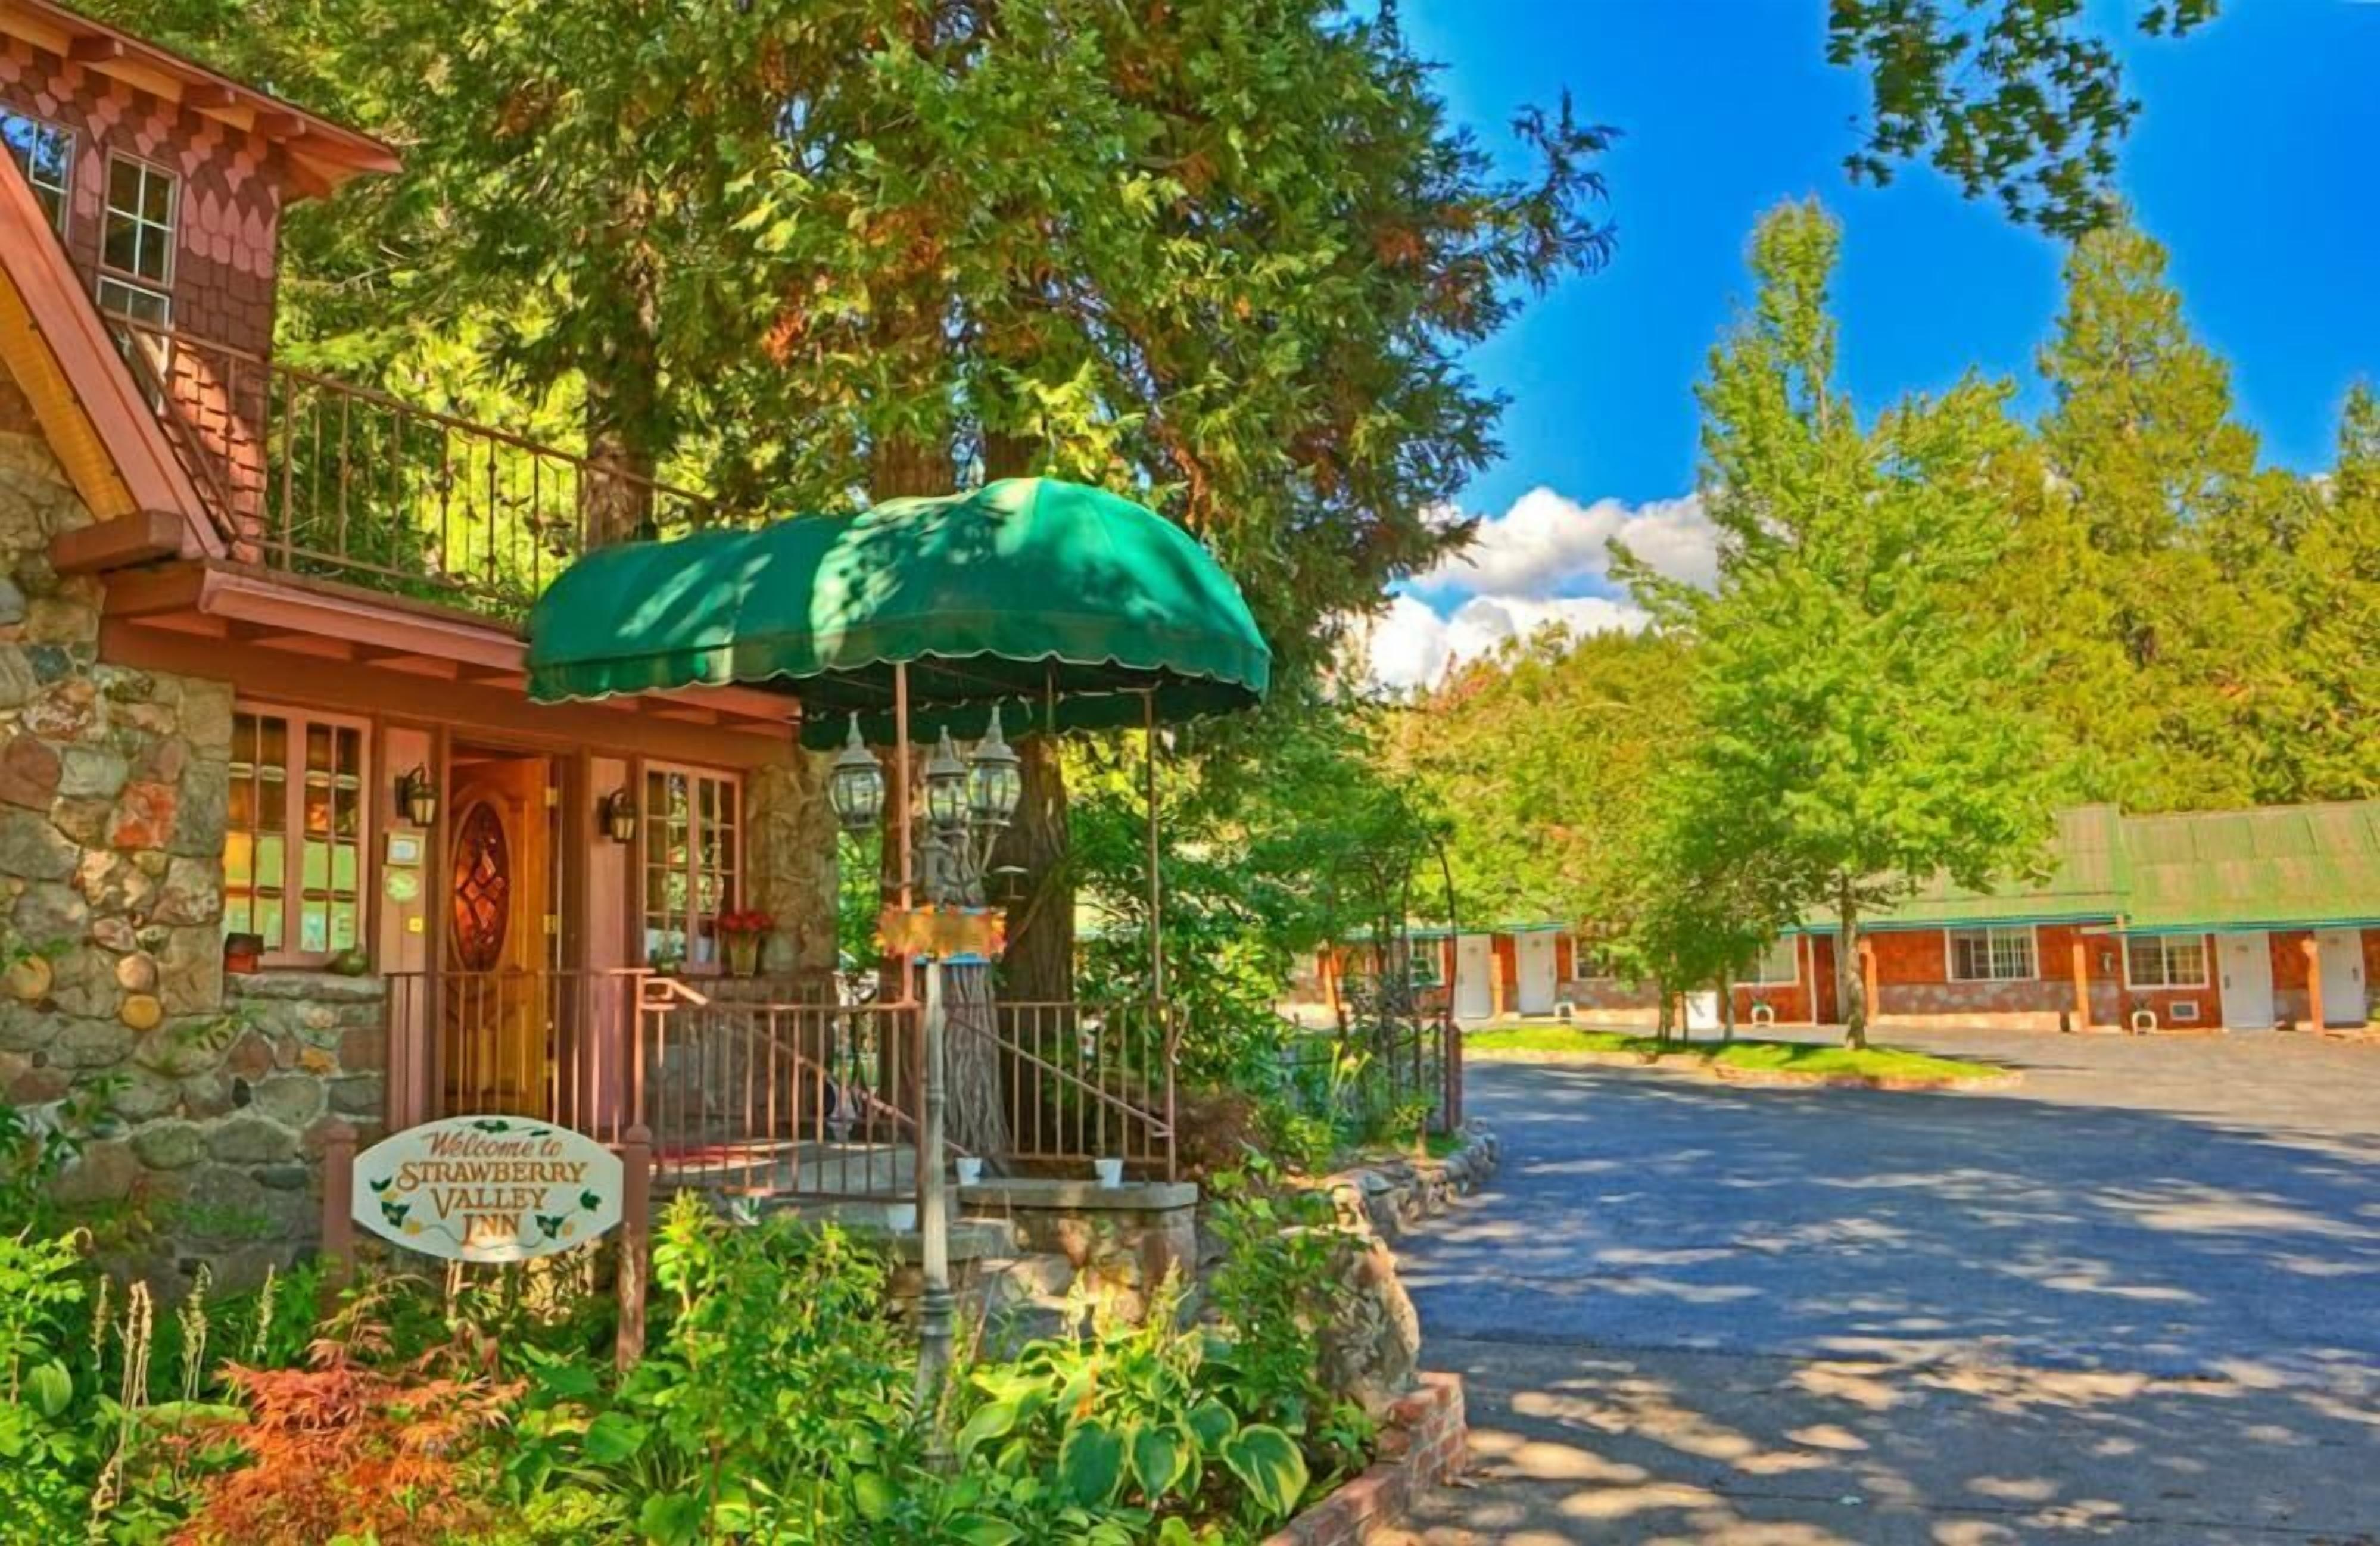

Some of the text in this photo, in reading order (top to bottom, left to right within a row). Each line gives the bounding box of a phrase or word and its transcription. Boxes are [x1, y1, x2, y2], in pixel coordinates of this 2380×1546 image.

[420, 1130, 563, 1157] Welcome to
[395, 1161, 588, 1191] STRAWBERRY
[429, 1188, 549, 1220] VALLEY
[462, 1213, 521, 1246] INN
